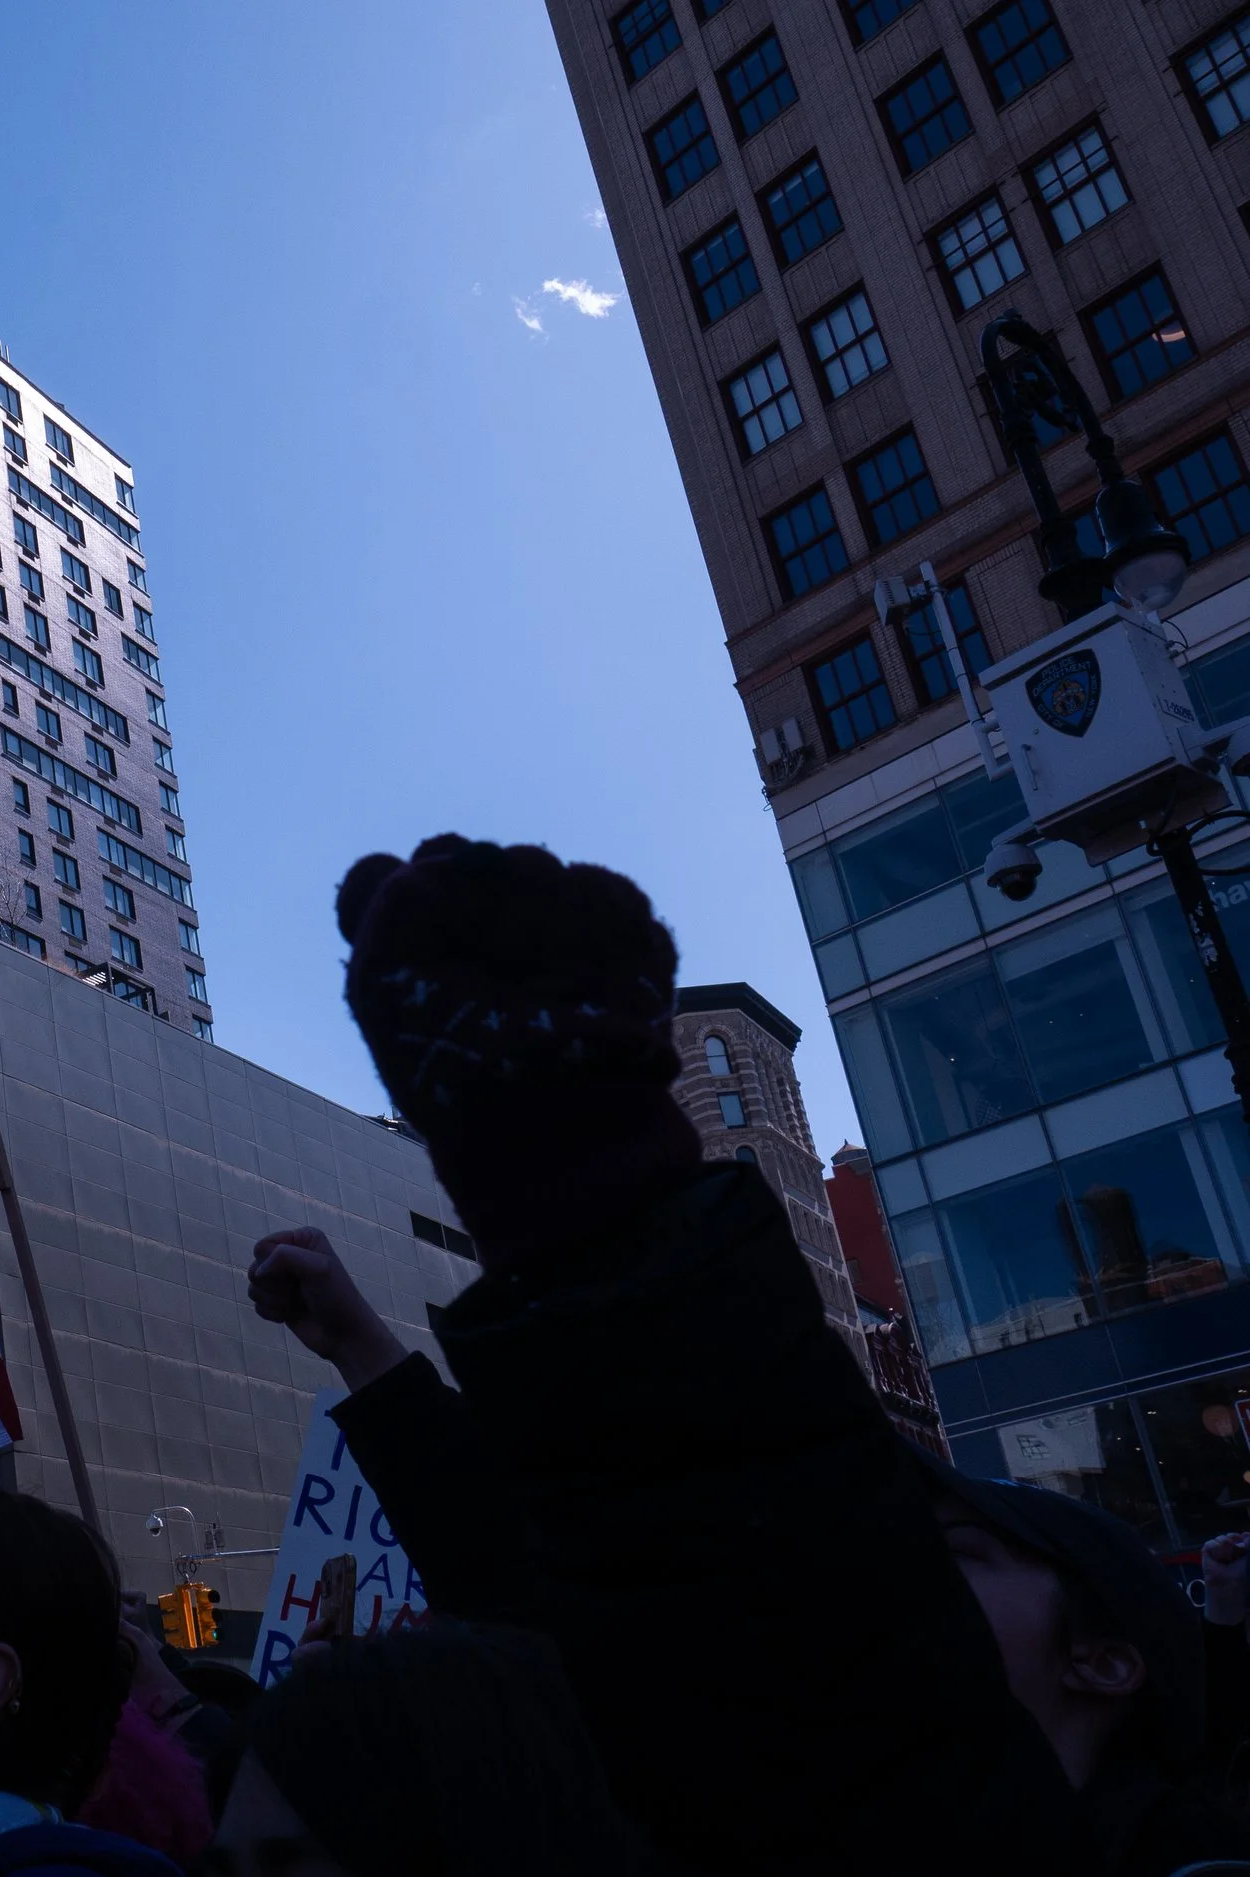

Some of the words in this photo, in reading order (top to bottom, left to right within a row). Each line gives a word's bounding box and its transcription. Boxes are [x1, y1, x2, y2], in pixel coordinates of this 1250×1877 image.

[1031, 661, 1090, 697] DEPARTMENT
[1041, 655, 1075, 678] POLICE
[1207, 879, 1250, 913] ha
